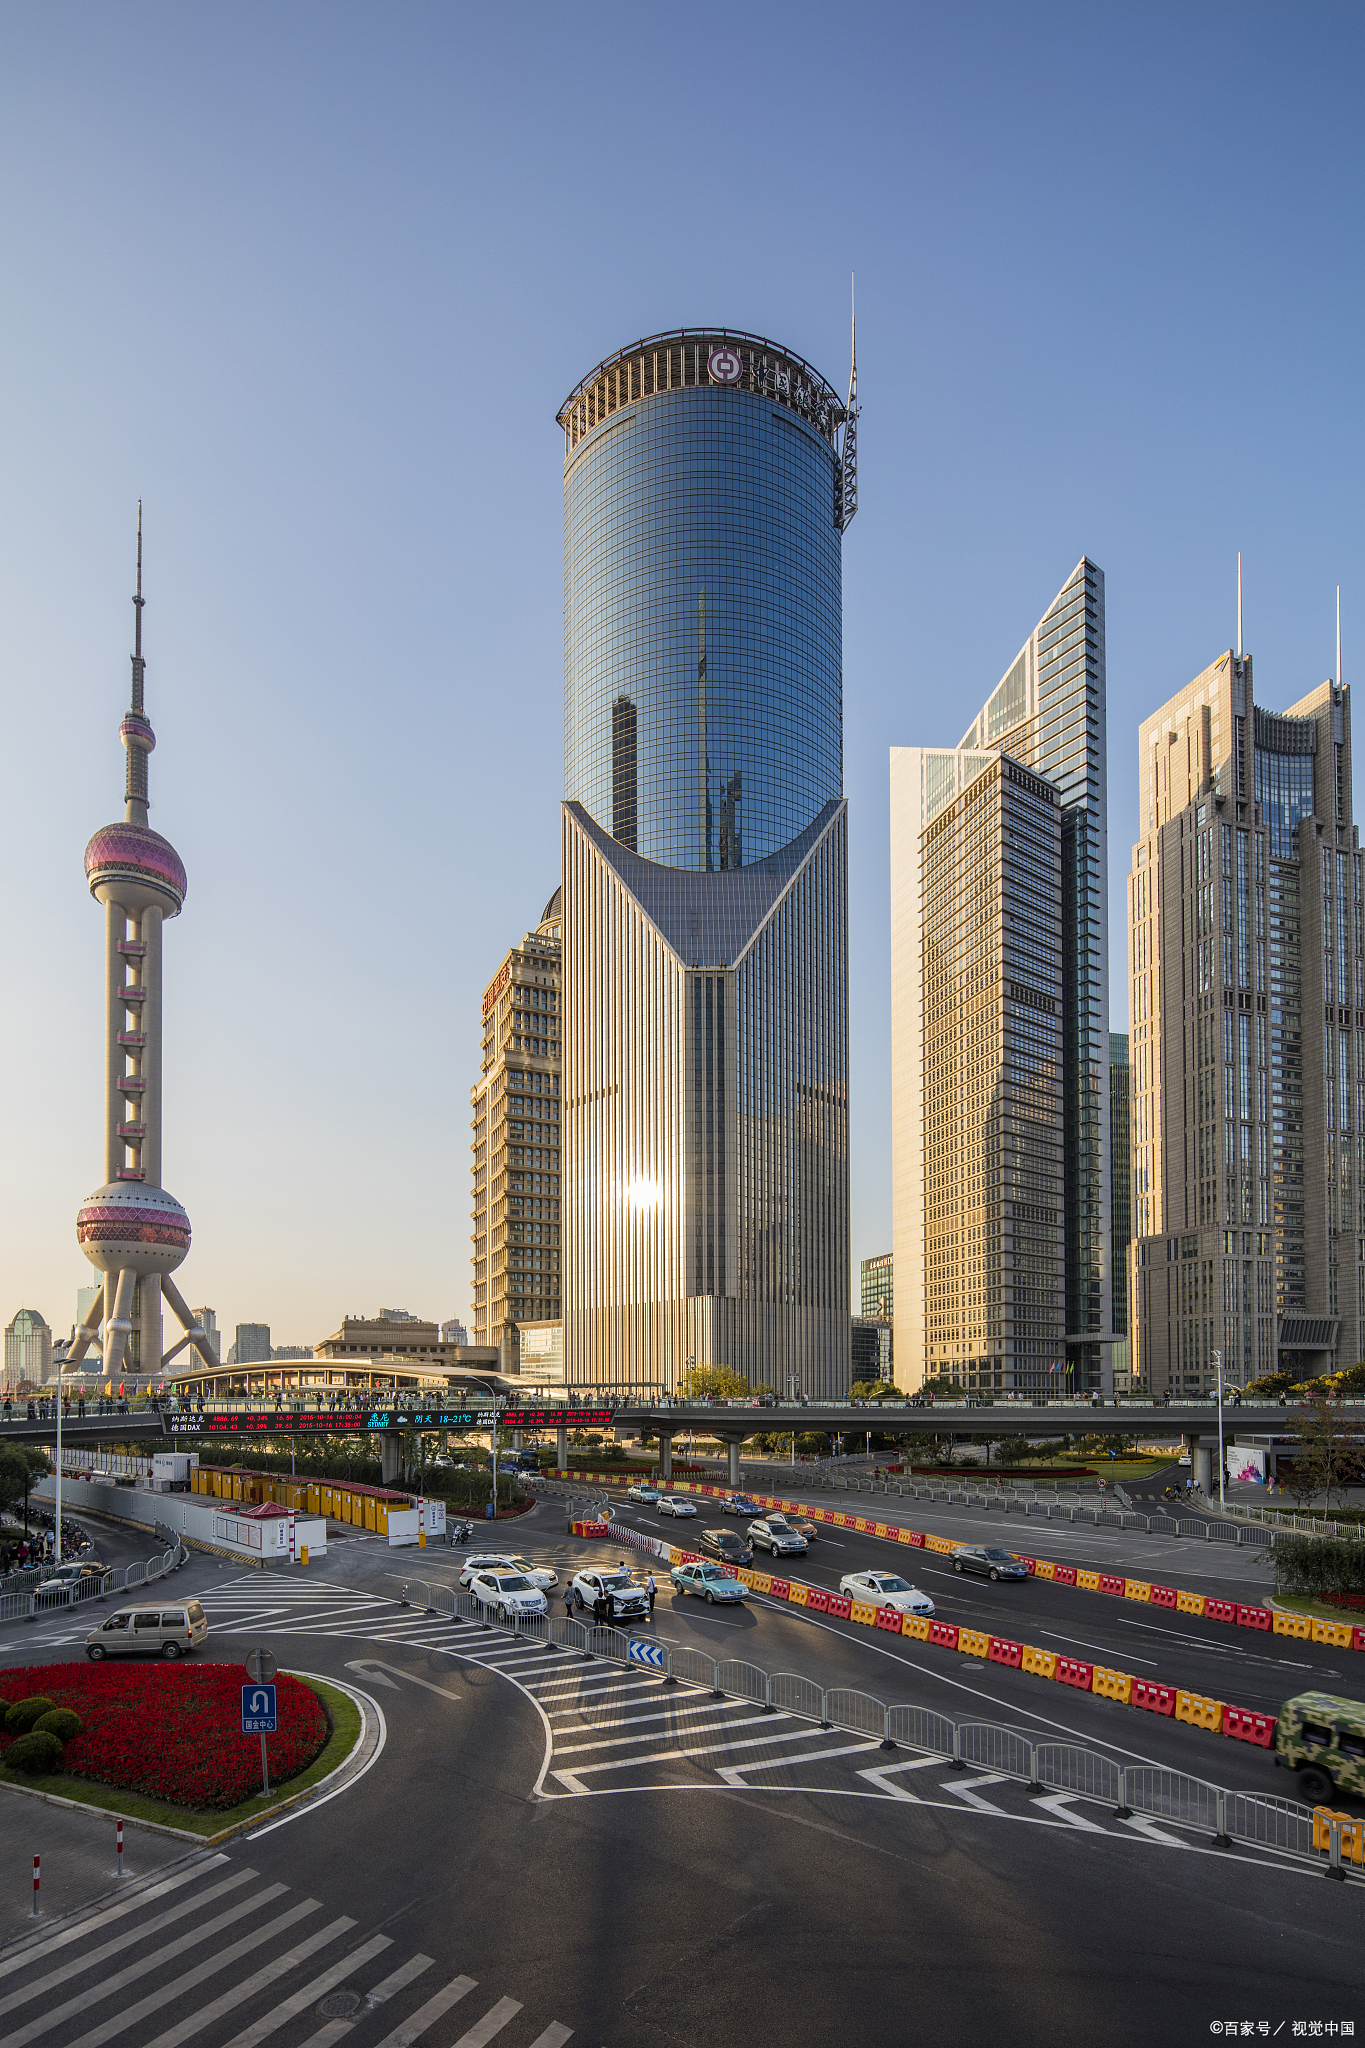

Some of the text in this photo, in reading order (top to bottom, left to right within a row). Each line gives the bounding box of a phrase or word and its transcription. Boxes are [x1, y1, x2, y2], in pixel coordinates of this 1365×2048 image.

[171, 1415, 205, 1423] 纳斯达克
[369, 1412, 390, 1422] 悉尼
[414, 1414, 433, 1424] 阴天
[171, 1424, 201, 1432] 德国DAX
[245, 1720, 274, 1730] 国金中心
